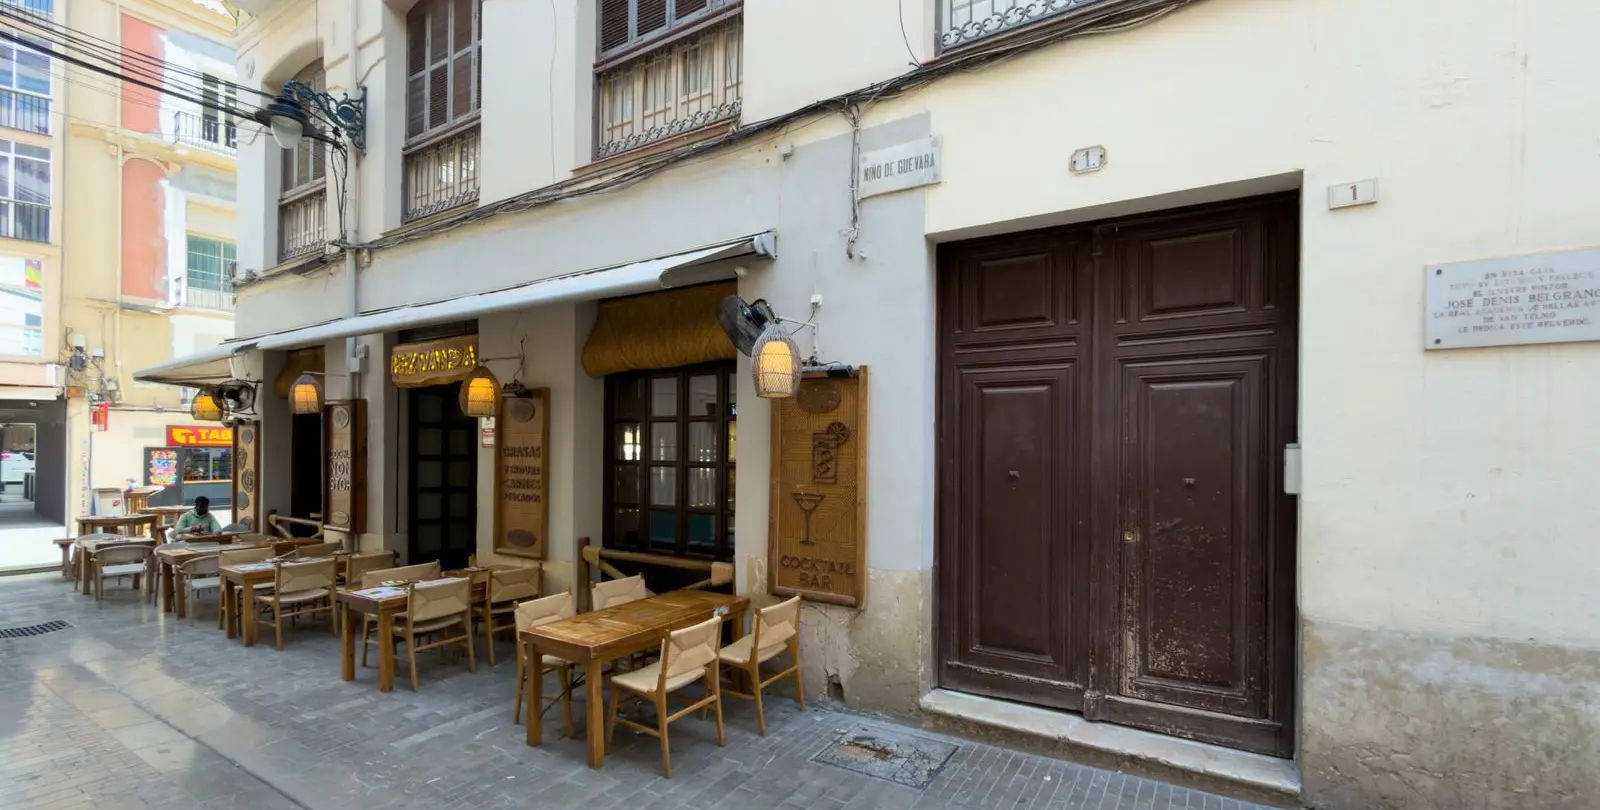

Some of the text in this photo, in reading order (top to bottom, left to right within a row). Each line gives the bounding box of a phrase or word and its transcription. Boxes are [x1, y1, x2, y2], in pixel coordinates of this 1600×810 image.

[884, 161, 895, 178] DE
[897, 153, 935, 175] GUEVARA
[1350, 185, 1358, 201] 1
[1531, 282, 1568, 292] PINTOR
[1482, 294, 1520, 307] DENIS
[1433, 311, 1446, 319] LA
[1448, 309, 1472, 317] REAL
[1474, 305, 1524, 316] ACADEMIA
[1528, 304, 1540, 312] DE
[1542, 301, 1580, 311] BELLAS
[1499, 314, 1518, 322] SAN
[1524, 311, 1557, 320] TELMO
[1457, 325, 1469, 334] LE
[1472, 323, 1505, 333] DEDICA
[1510, 321, 1533, 330] ESTE
[781, 555, 855, 575] COCKTAIL
[799, 572, 832, 590] BAR
